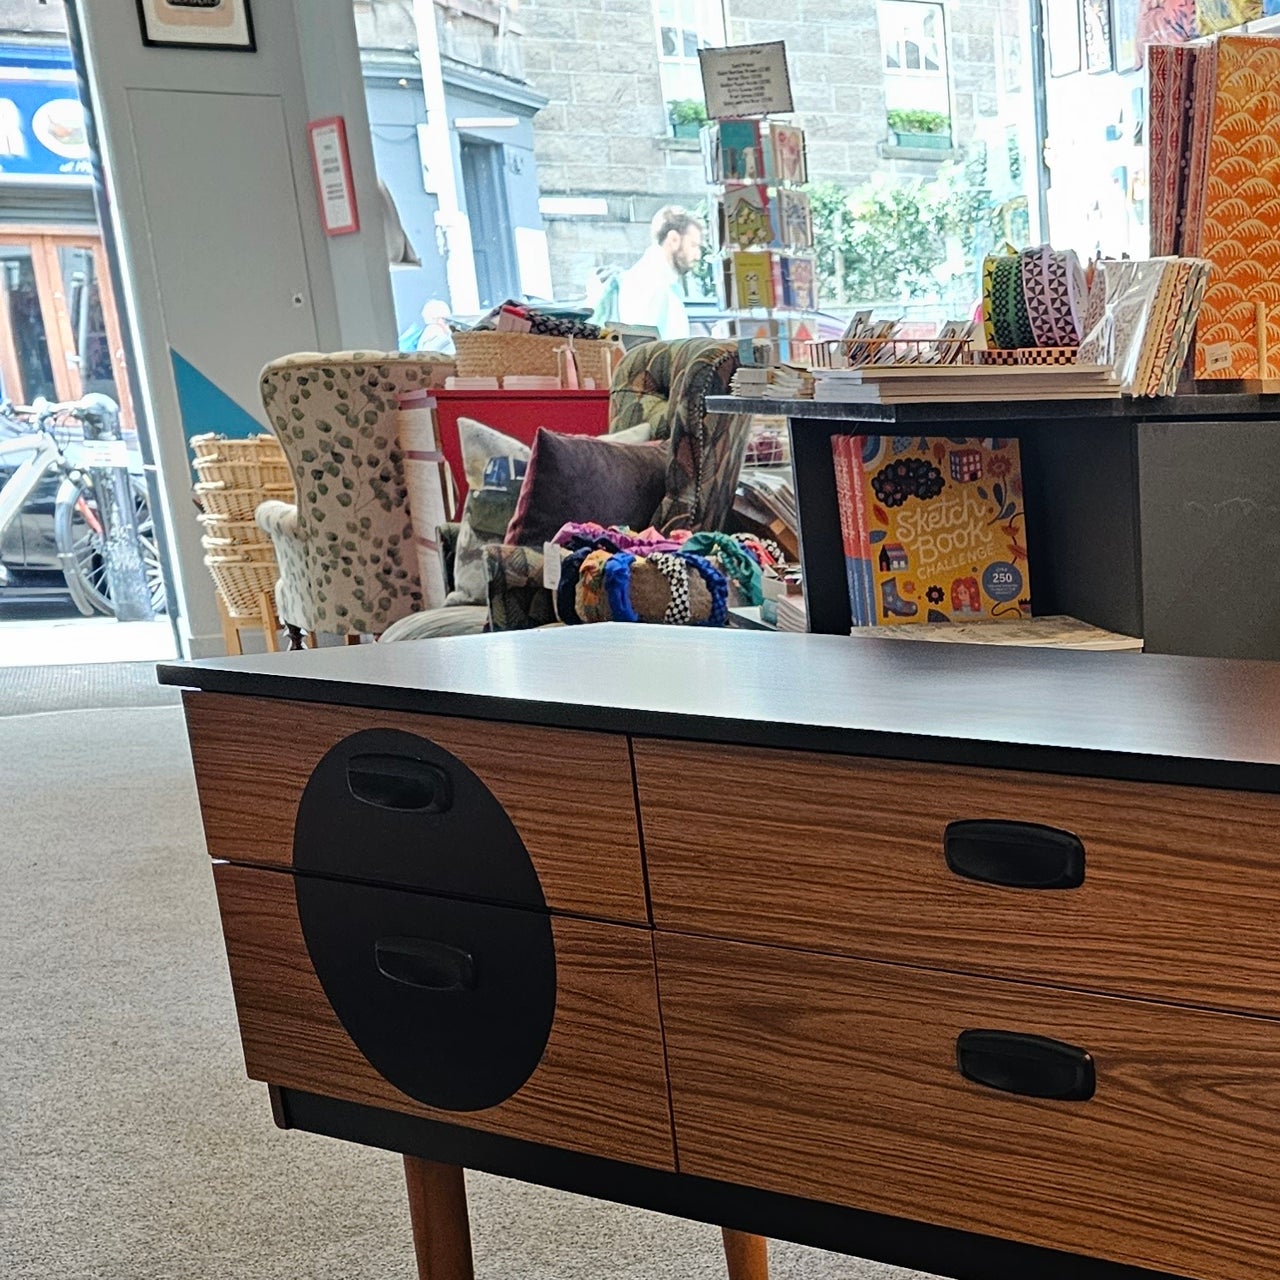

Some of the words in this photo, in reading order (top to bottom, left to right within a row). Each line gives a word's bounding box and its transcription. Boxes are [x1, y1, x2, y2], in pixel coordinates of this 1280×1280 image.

[896, 490, 986, 543] Sketch
[917, 544, 995, 581] CHALLENGE
[992, 573, 1013, 583] 250
